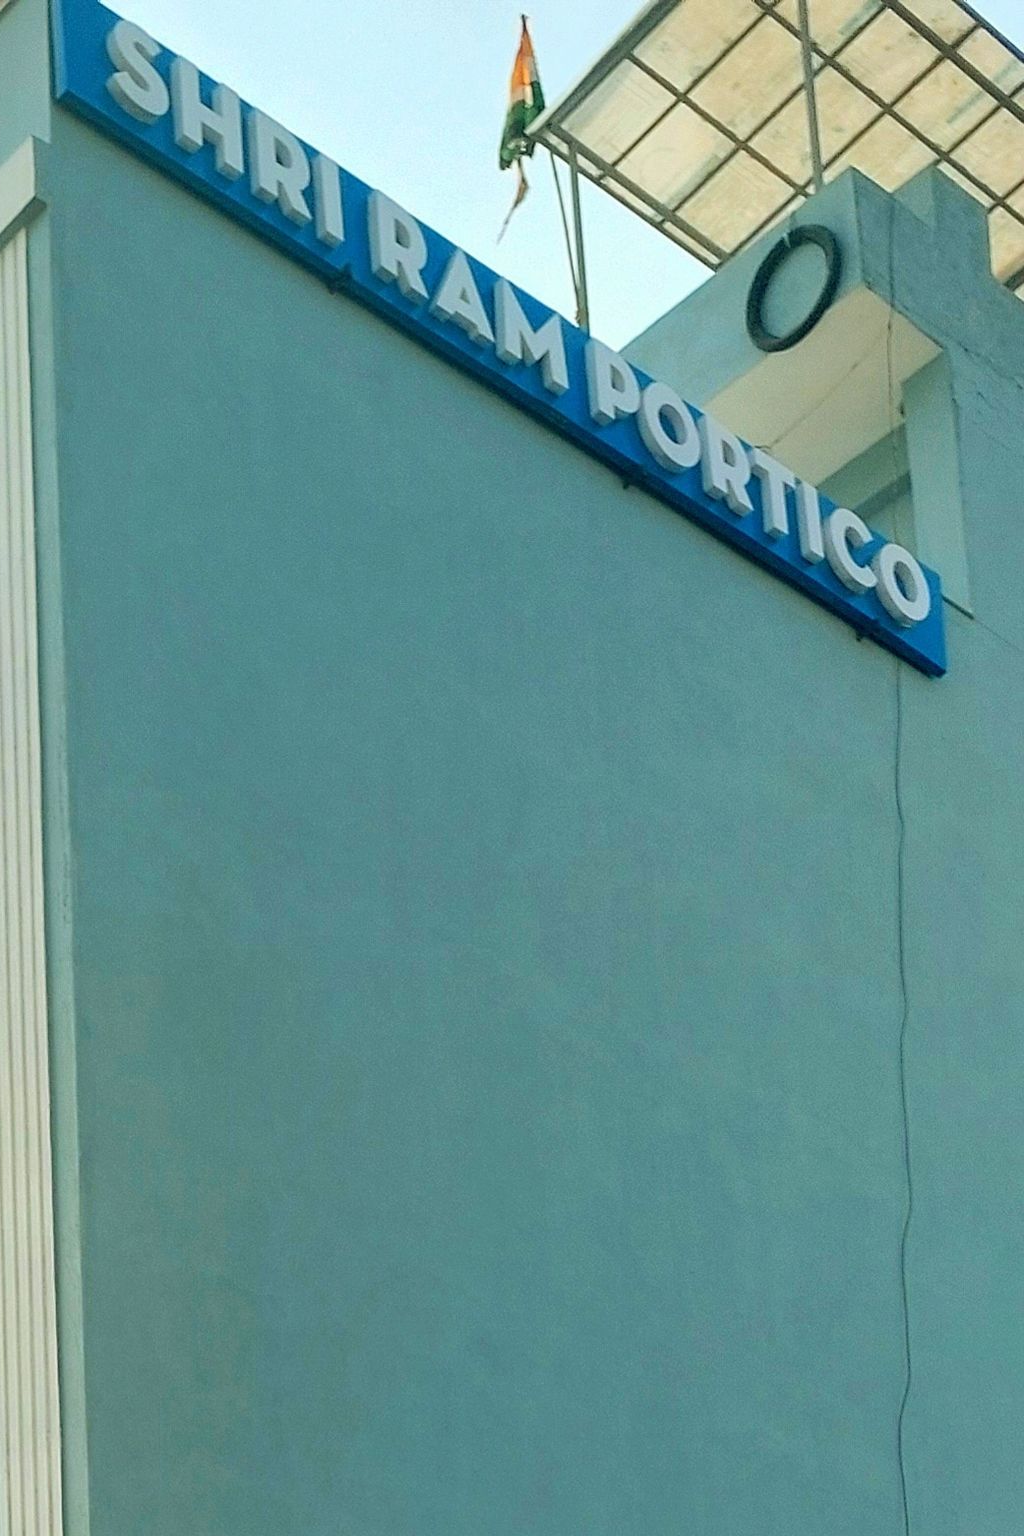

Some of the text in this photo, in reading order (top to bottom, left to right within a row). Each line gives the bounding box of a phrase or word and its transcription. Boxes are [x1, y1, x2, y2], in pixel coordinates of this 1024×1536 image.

[106, 19, 932, 628] SHRI RAM PORTICO
